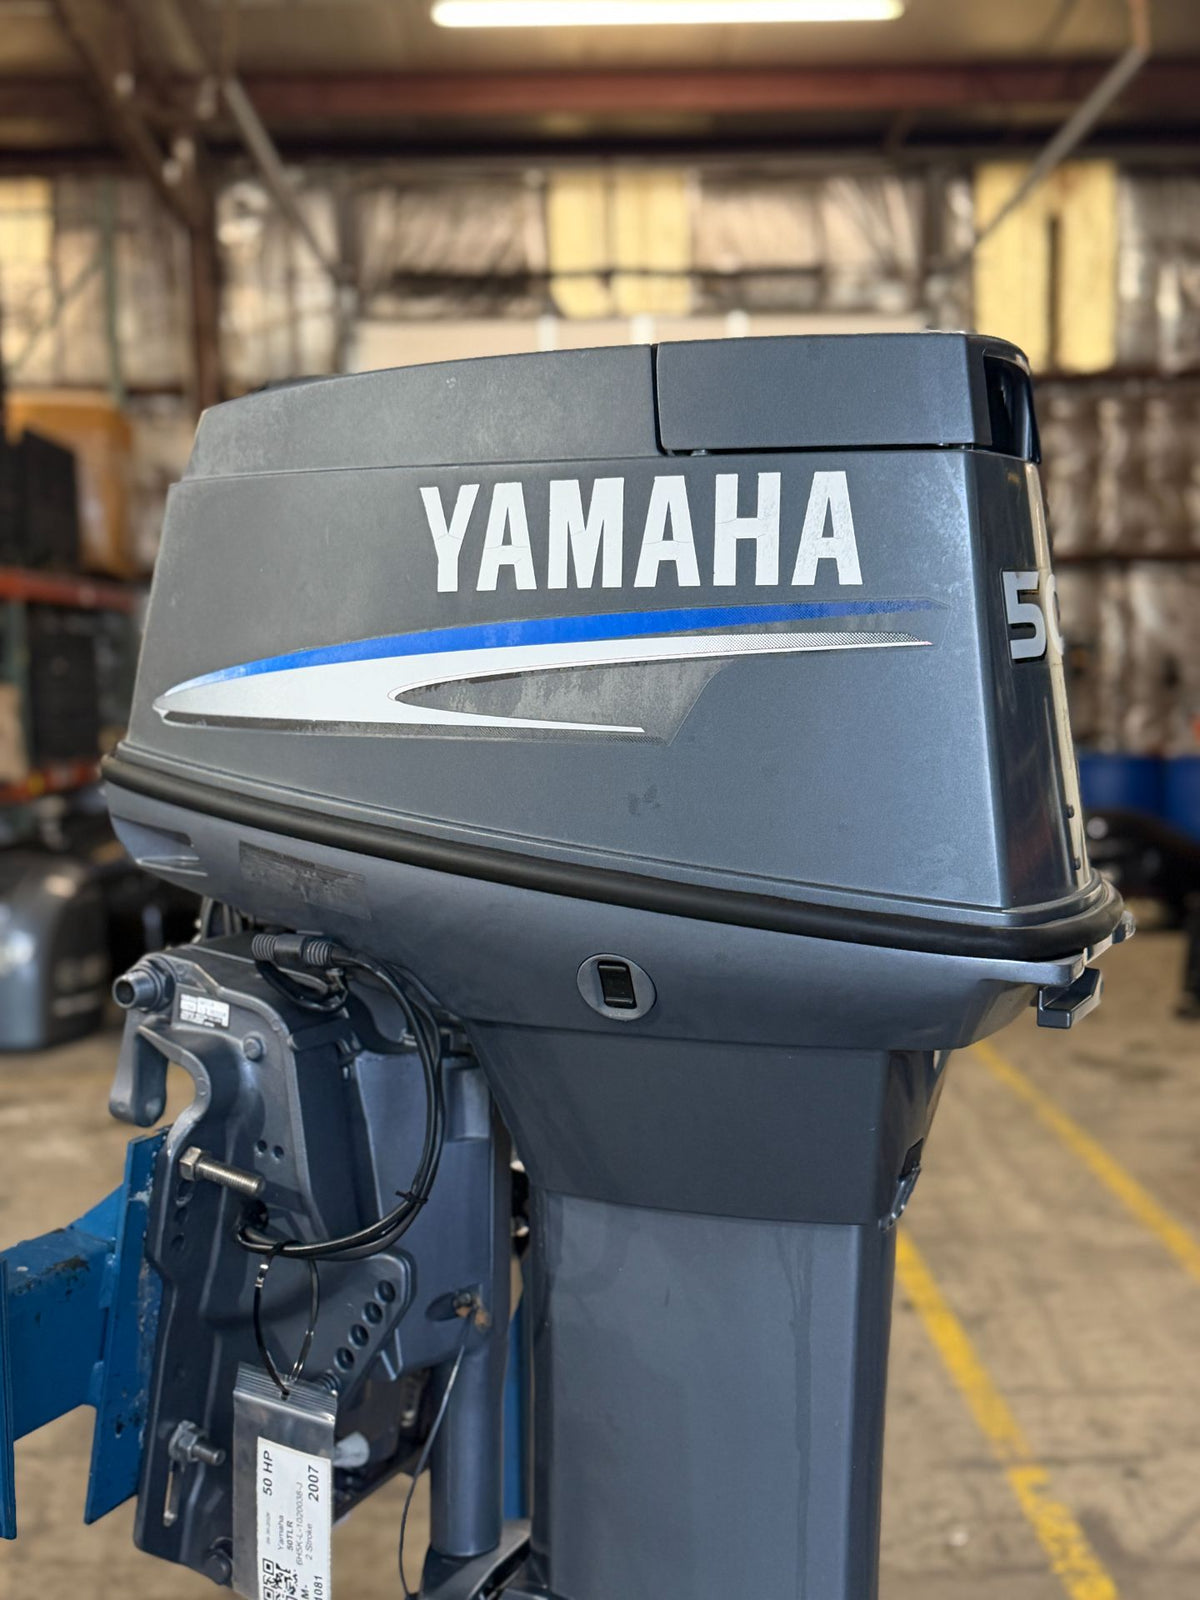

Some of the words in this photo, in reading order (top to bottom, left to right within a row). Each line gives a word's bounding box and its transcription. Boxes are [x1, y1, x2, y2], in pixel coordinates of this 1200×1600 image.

[419, 470, 863, 592] YAMAHA
[263, 1450, 273, 1474] HP
[263, 1478, 273, 1496] 50
[308, 1465, 320, 1502] 2007
[277, 1515, 285, 1550] Yamaha
[286, 1520, 294, 1552] 50TLR
[305, 1523, 313, 1553] Stroke
